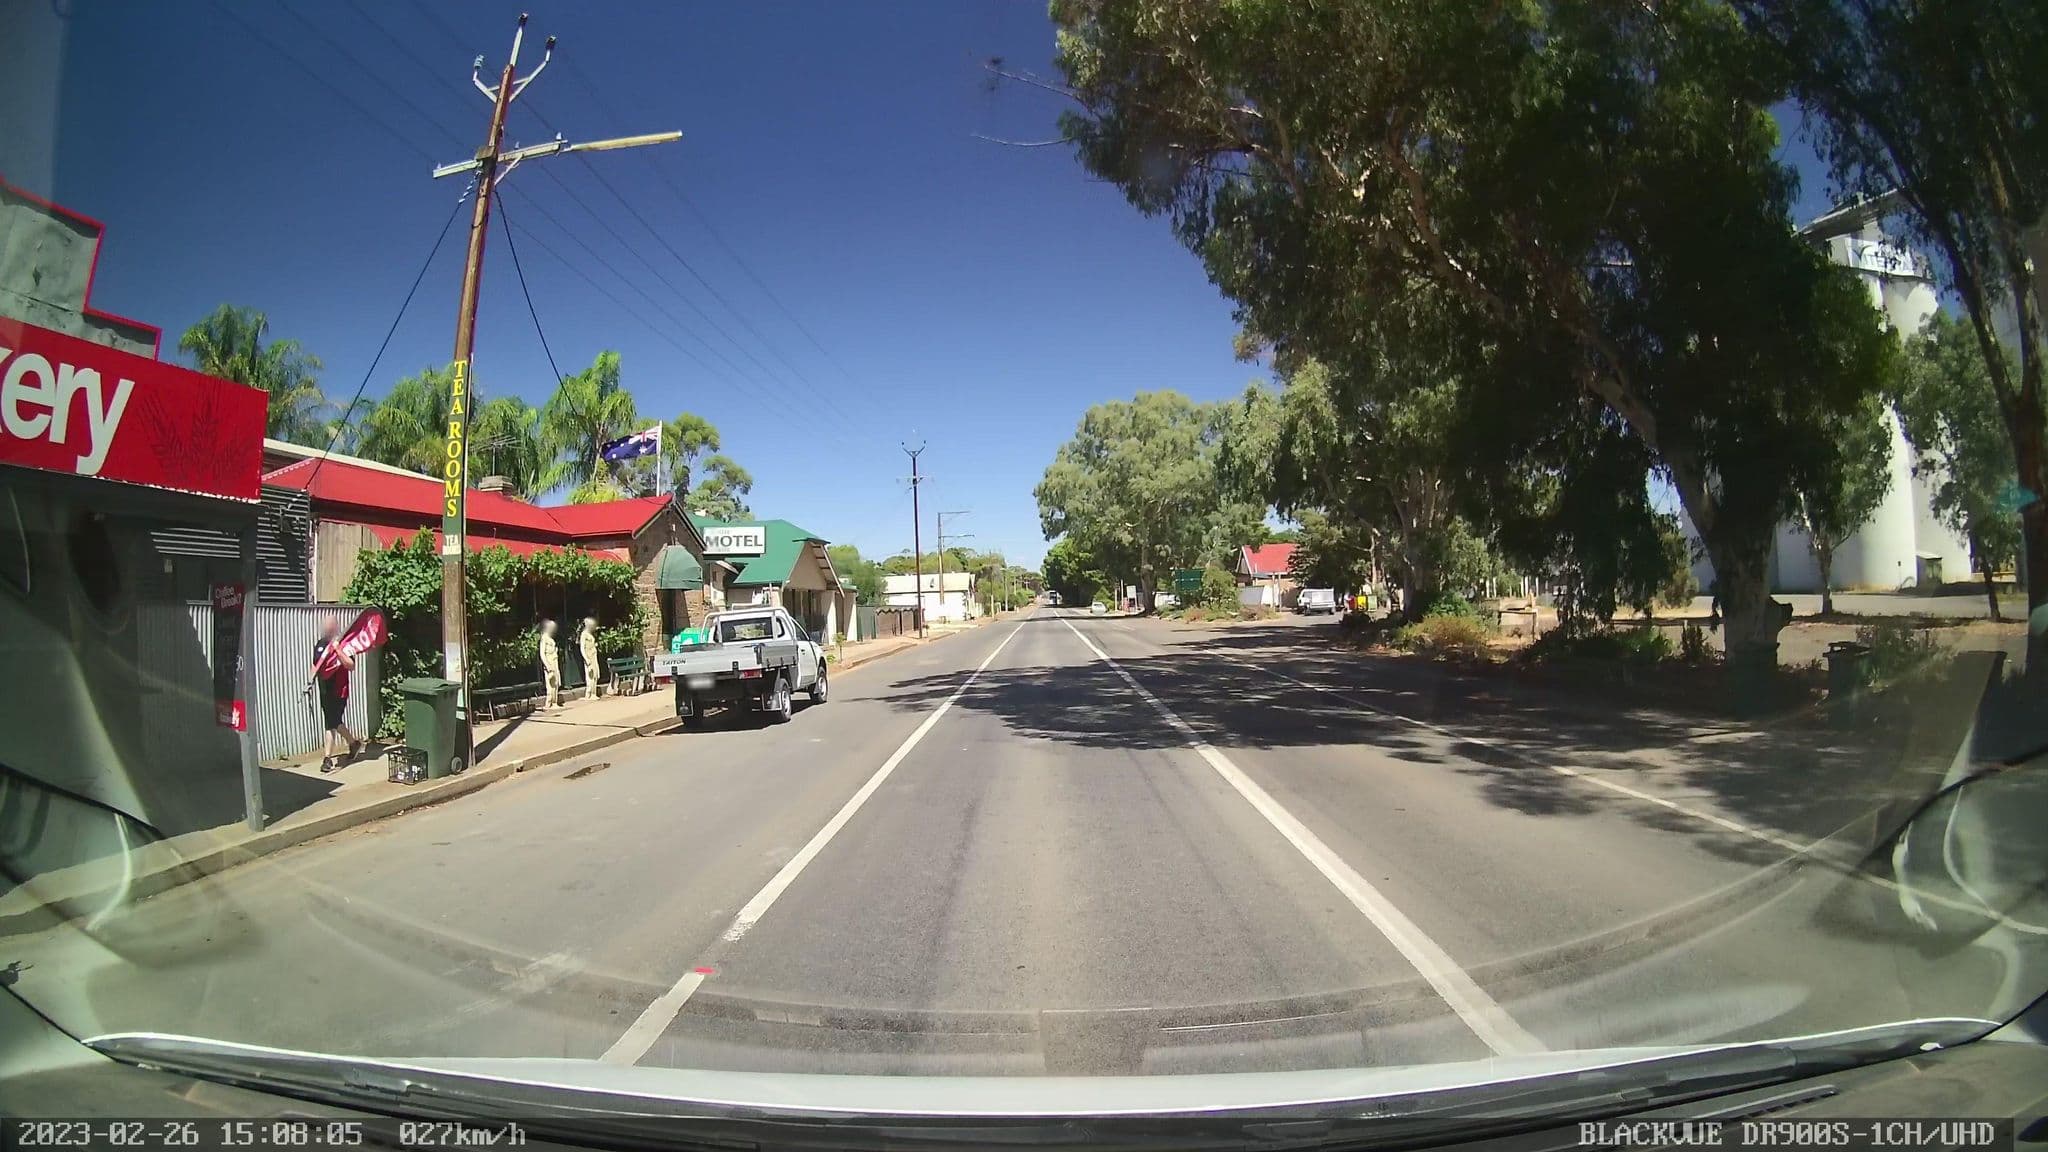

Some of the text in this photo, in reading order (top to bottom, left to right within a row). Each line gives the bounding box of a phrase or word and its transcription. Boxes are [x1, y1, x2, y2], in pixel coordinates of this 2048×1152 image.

[0, 346, 135, 476] ery
[444, 360, 467, 518] TEA ROOMS
[705, 535, 763, 547] MOTEL
